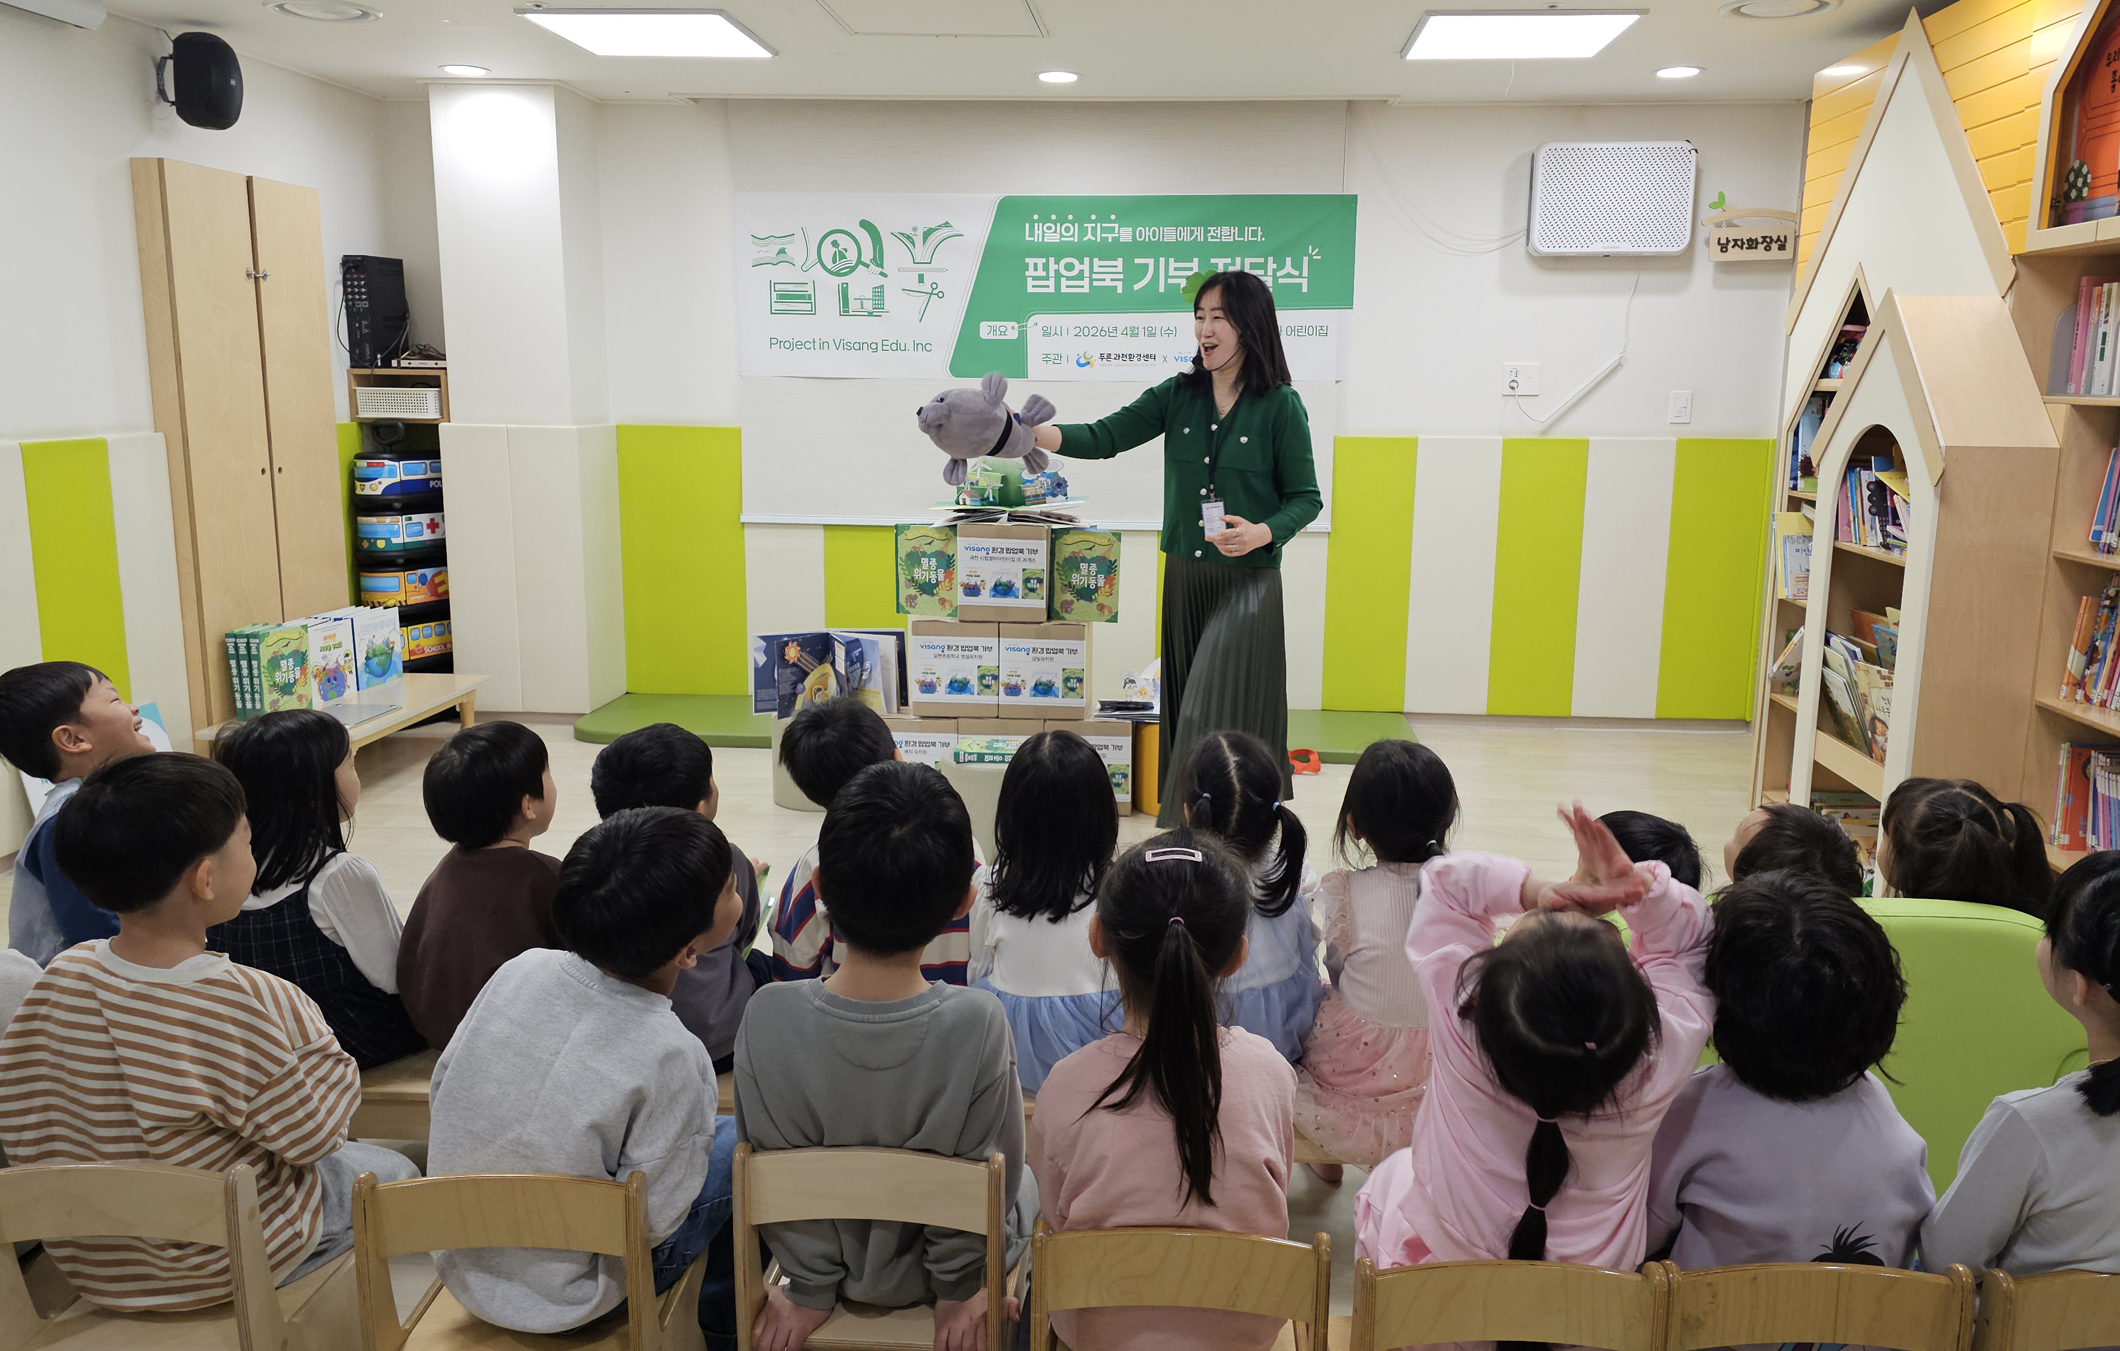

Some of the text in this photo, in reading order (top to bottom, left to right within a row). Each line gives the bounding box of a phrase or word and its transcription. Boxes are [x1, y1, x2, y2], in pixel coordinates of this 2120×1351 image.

[1025, 222, 1265, 242] 내일의 지구를 아이들에게 전합니다.
[1717, 234, 1788, 253] 남자화장실
[1025, 256, 1124, 293] 팝업북
[1133, 256, 1199, 293] 기부
[986, 324, 1009, 337] 개요
[1041, 325, 1064, 338] 일시
[1073, 325, 1118, 338] 2026년
[1120, 325, 1140, 338] 4월
[1142, 325, 1157, 338] 1일
[1160, 325, 1178, 338] (수)
[1285, 325, 1329, 337] 어린이집
[769, 337, 933, 353] Project in Visang Edu. Inc
[1041, 353, 1063, 365] 주관
[964, 546, 991, 555] visang
[1005, 547, 1025, 555] 팝업북
[1026, 547, 1039, 555] 기부
[921, 557, 938, 571] 멸종
[1080, 562, 1098, 576] 멸종
[424, 644, 446, 653] SCHOOL
[919, 643, 946, 653] visang
[960, 644, 980, 652] 팝업북
[980, 645, 993, 653] 기부
[1004, 646, 1031, 656] visang
[1045, 647, 1065, 655] 팝업북
[1065, 647, 1078, 655] 기부
[280, 657, 295, 672] 멸종
